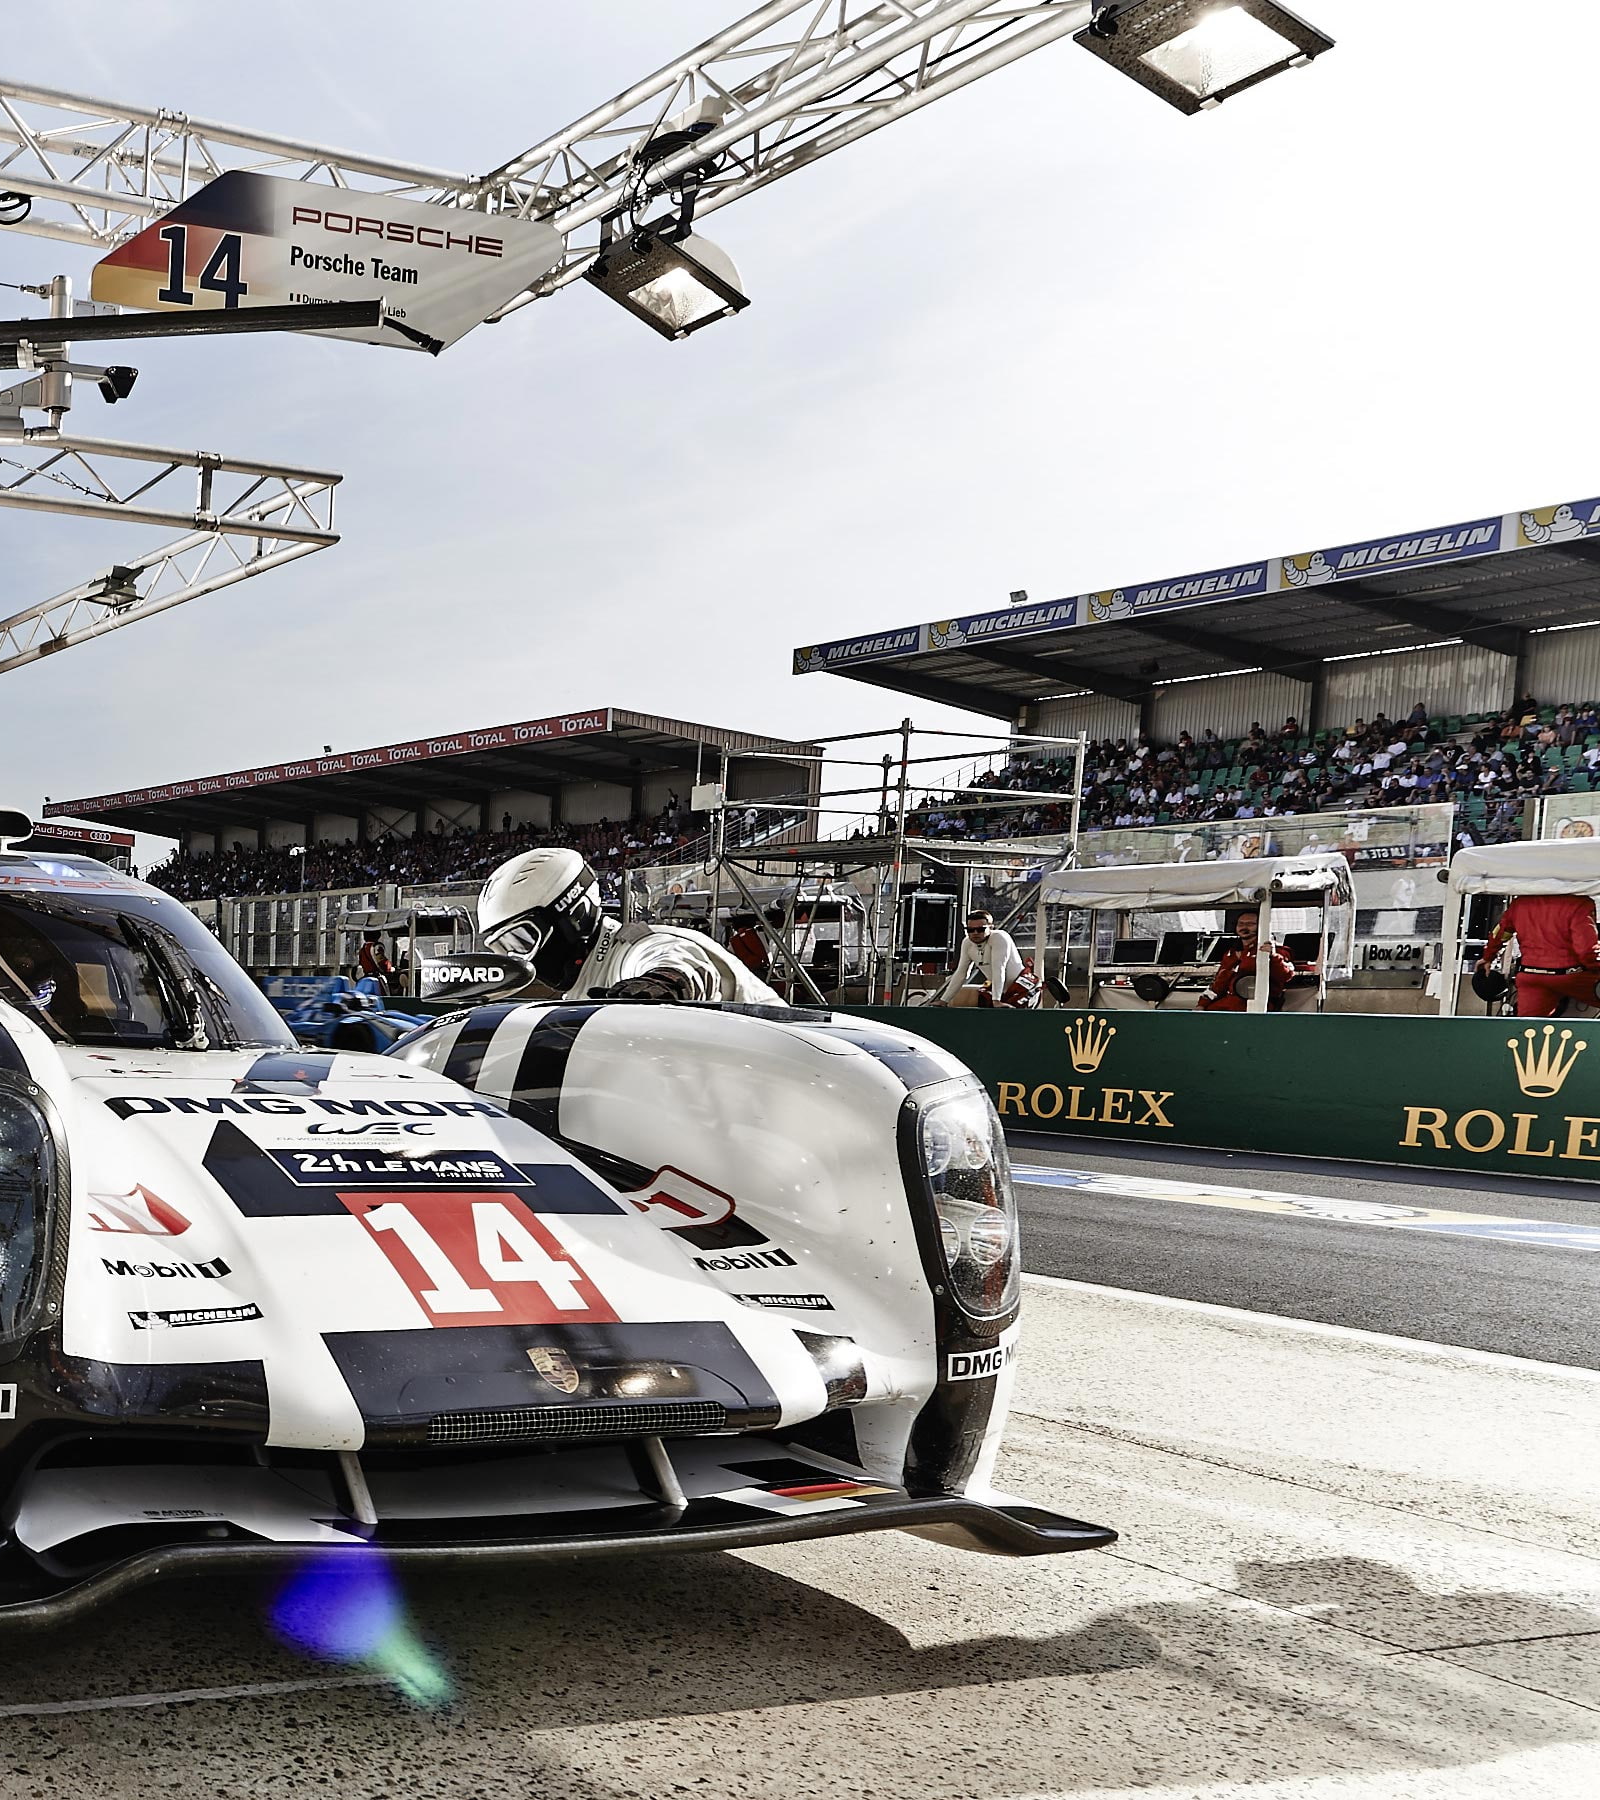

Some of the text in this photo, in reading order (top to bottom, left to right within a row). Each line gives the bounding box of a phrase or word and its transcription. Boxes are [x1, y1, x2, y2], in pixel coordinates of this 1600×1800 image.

[292, 207, 503, 258] PORSCHE
[157, 225, 247, 308] 14
[290, 246, 418, 286] Porsche Team
[387, 307, 407, 319] Lieb
[1337, 525, 1497, 571] MICHELIN
[1133, 570, 1264, 608] MICHELIN
[966, 604, 1074, 635] MICHELIN
[827, 631, 917, 661] MICHELIN
[102, 797, 122, 808] TOTAL
[124, 793, 145, 805] TOTAL
[147, 789, 169, 800] TOTAL
[171, 784, 194, 796] TOTAL
[197, 779, 221, 791] TOTAL
[224, 775, 250, 787] TOTAL
[253, 770, 280, 782] TOTAL
[283, 764, 312, 777] TOTAL
[316, 759, 346, 772] TOTAL
[350, 753, 382, 766] TOTAL
[387, 746, 421, 761] TOTAL
[426, 740, 463, 754] TOTAL
[468, 732, 506, 747] TOTAL
[512, 725, 553, 740] TOTAL
[559, 716, 603, 732] TOTAL
[35, 824, 83, 838] Audi Sport
[554, 880, 585, 912] uvex
[596, 924, 613, 962] CHOP
[1369, 944, 1411, 961] Box 22
[421, 966, 505, 983] CHOPARD
[104, 1096, 508, 1121] DMG MOR
[997, 1081, 1174, 1128] ROLEX
[1399, 1105, 1600, 1162] ROLE
[293, 1153, 502, 1173] 24h LE MANS
[101, 1258, 196, 1278] Mobil
[360, 1202, 589, 1314] 14
[169, 1306, 257, 1323] MICHELIN
[758, 1296, 828, 1306] MICHELIN
[952, 1350, 1002, 1377] DMG
